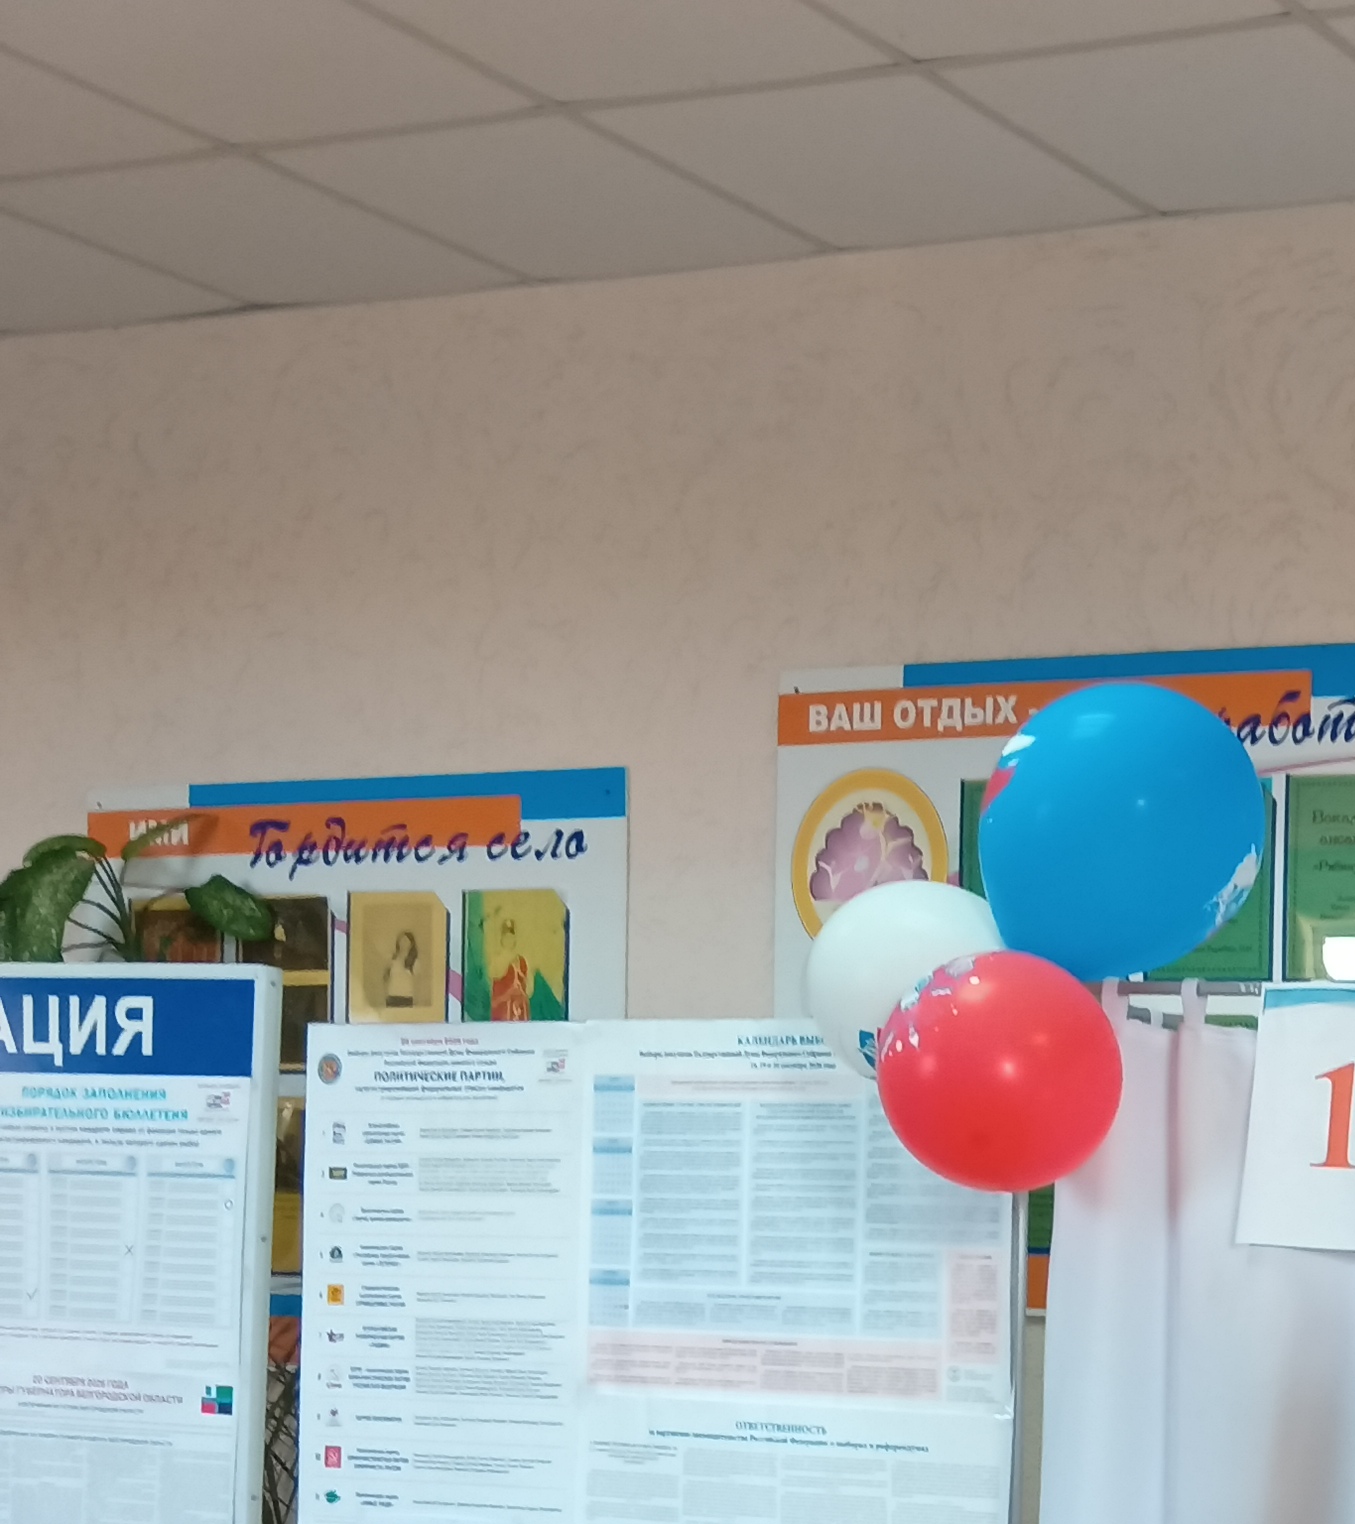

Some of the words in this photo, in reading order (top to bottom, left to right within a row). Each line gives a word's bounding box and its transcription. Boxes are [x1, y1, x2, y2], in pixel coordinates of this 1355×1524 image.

[808, 700, 883, 732] ВАШ
[892, 694, 1018, 733] ОТДЫХ
[486, 828, 591, 862] село
